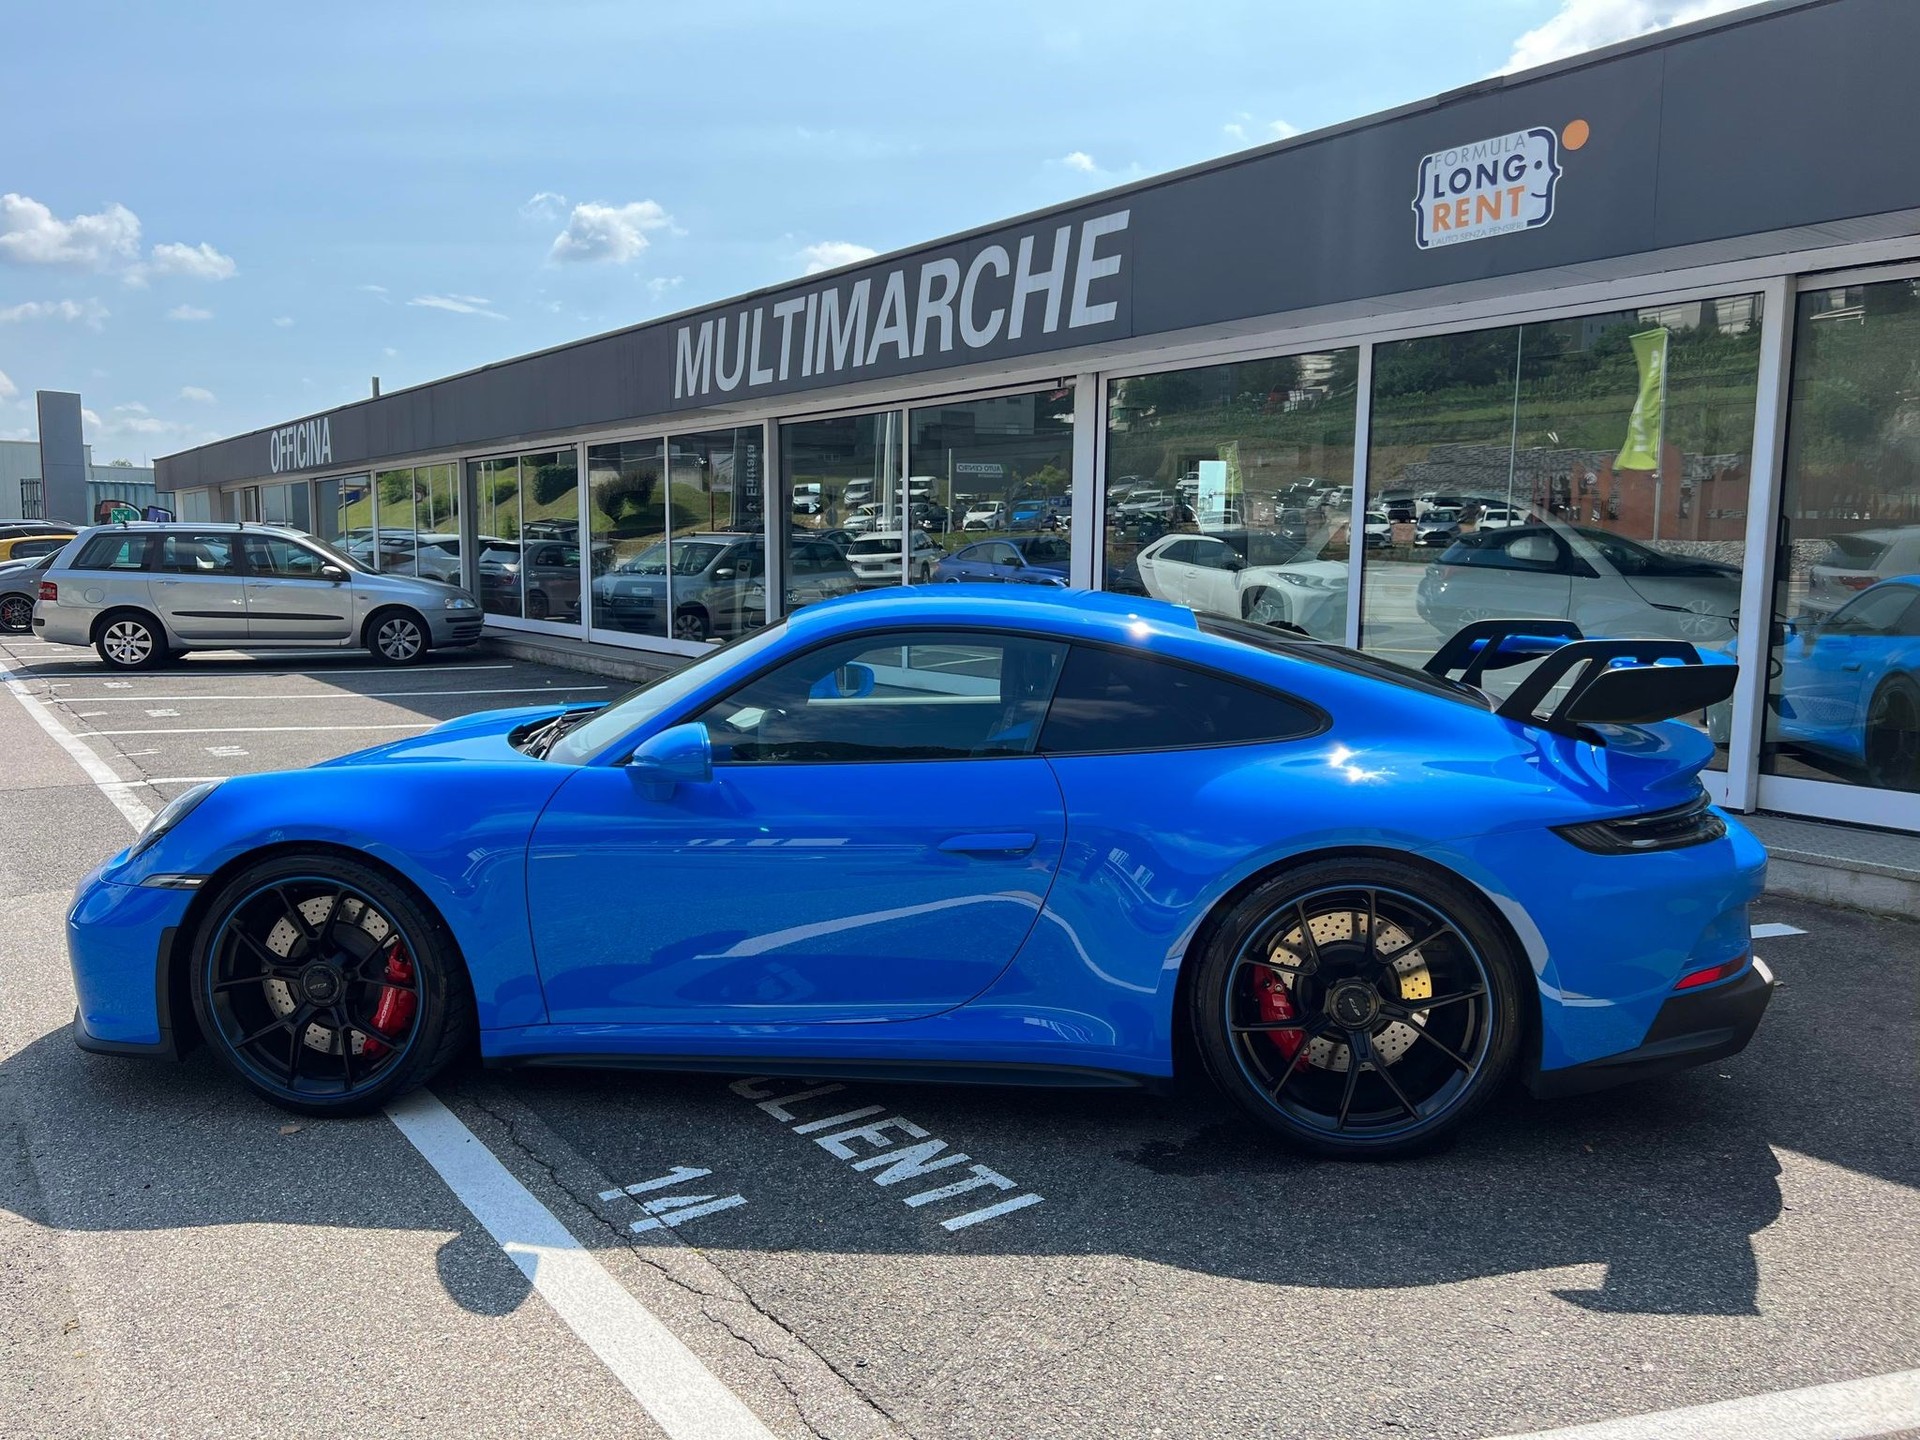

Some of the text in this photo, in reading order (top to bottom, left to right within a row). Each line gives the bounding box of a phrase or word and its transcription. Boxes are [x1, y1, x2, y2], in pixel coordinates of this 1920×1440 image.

[1433, 134, 1526, 170] FORMULA
[1433, 153, 1527, 199] LONG
[1432, 185, 1525, 234] RENT
[1460, 229, 1487, 242] SENZA
[673, 208, 1131, 399] MULTIMARCHE
[270, 416, 332, 474] OFFICINA
[378, 987, 394, 1028] PORSCHE
[728, 1076, 1046, 1232] CLIENTI
[598, 1165, 748, 1234] 14
